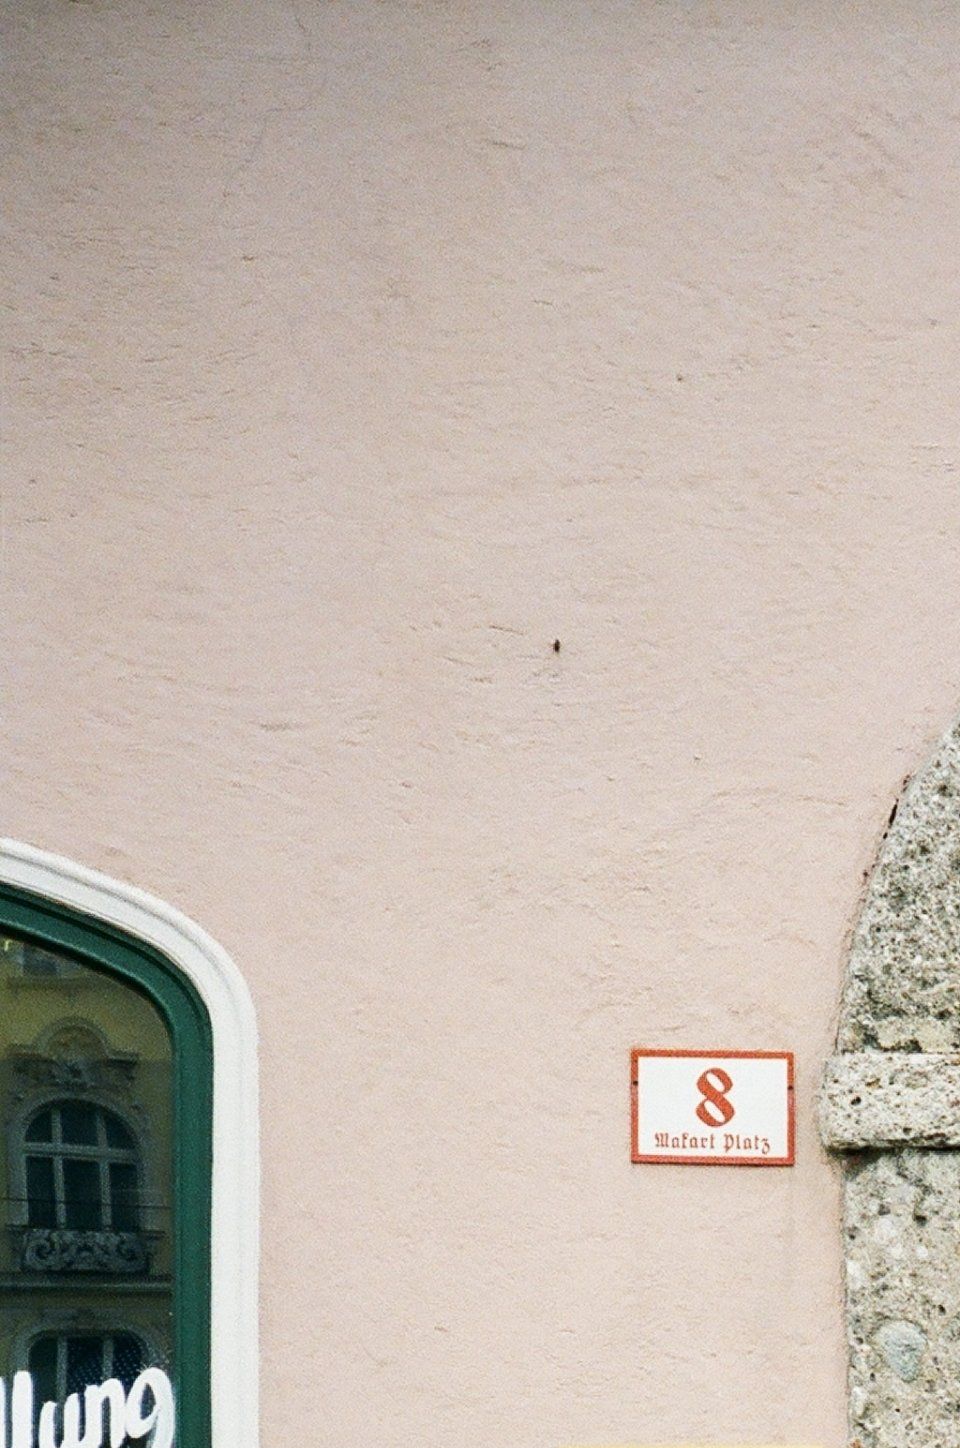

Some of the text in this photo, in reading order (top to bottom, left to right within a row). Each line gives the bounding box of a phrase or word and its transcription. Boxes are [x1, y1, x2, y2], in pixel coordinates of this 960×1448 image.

[695, 1067, 735, 1128] 8
[654, 1131, 771, 1155] Makart Platz
